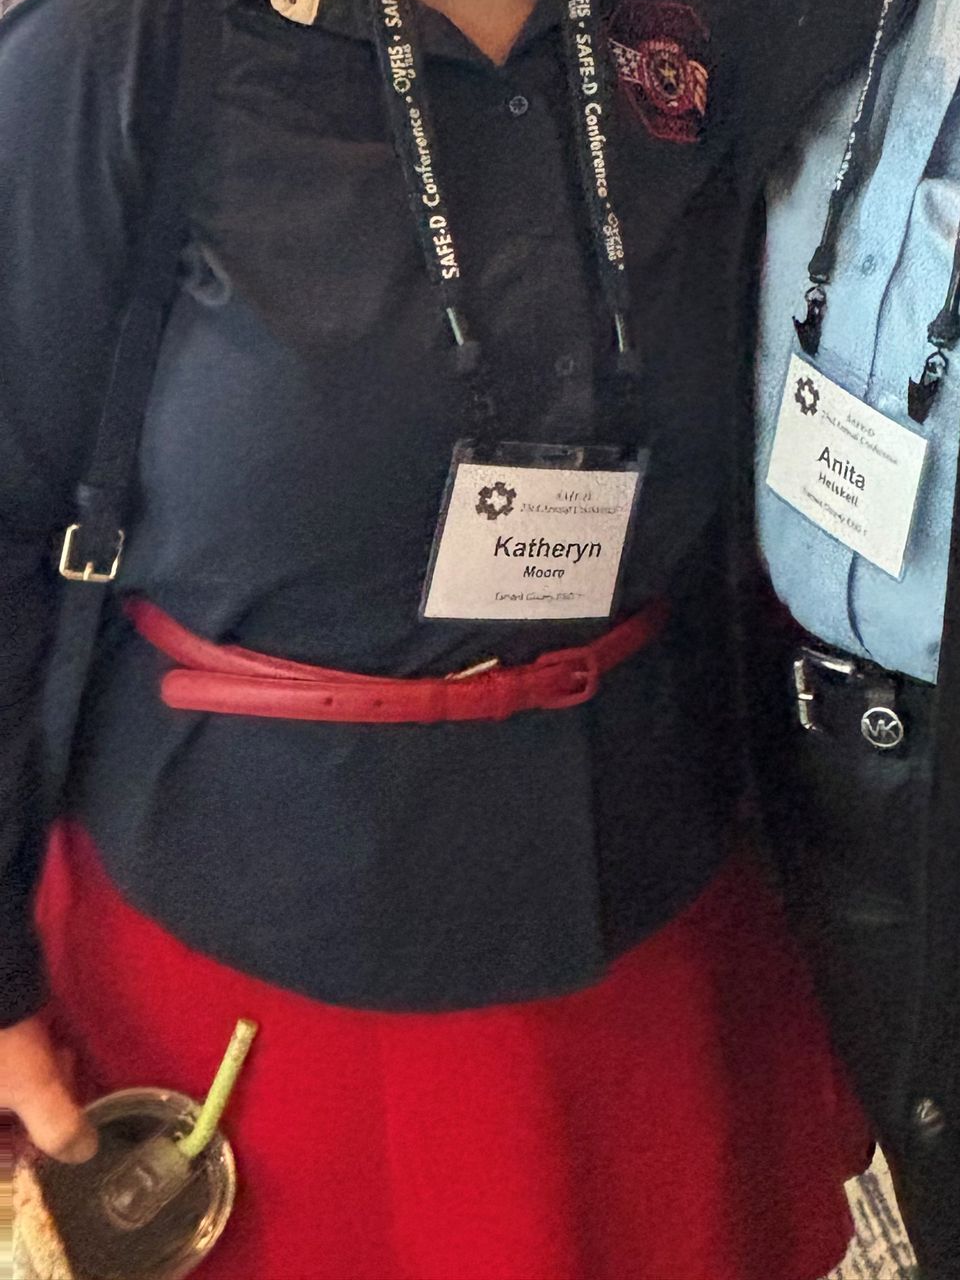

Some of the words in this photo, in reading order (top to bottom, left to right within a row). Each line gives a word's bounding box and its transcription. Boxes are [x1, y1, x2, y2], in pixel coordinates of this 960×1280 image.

[576, 33, 598, 95] SAFE-D
[409, 107, 440, 208] Conference
[585, 103, 608, 198] Conference
[429, 215, 460, 280] SAFE-D
[817, 446, 865, 491] Anita
[494, 536, 602, 564] Katheryn
